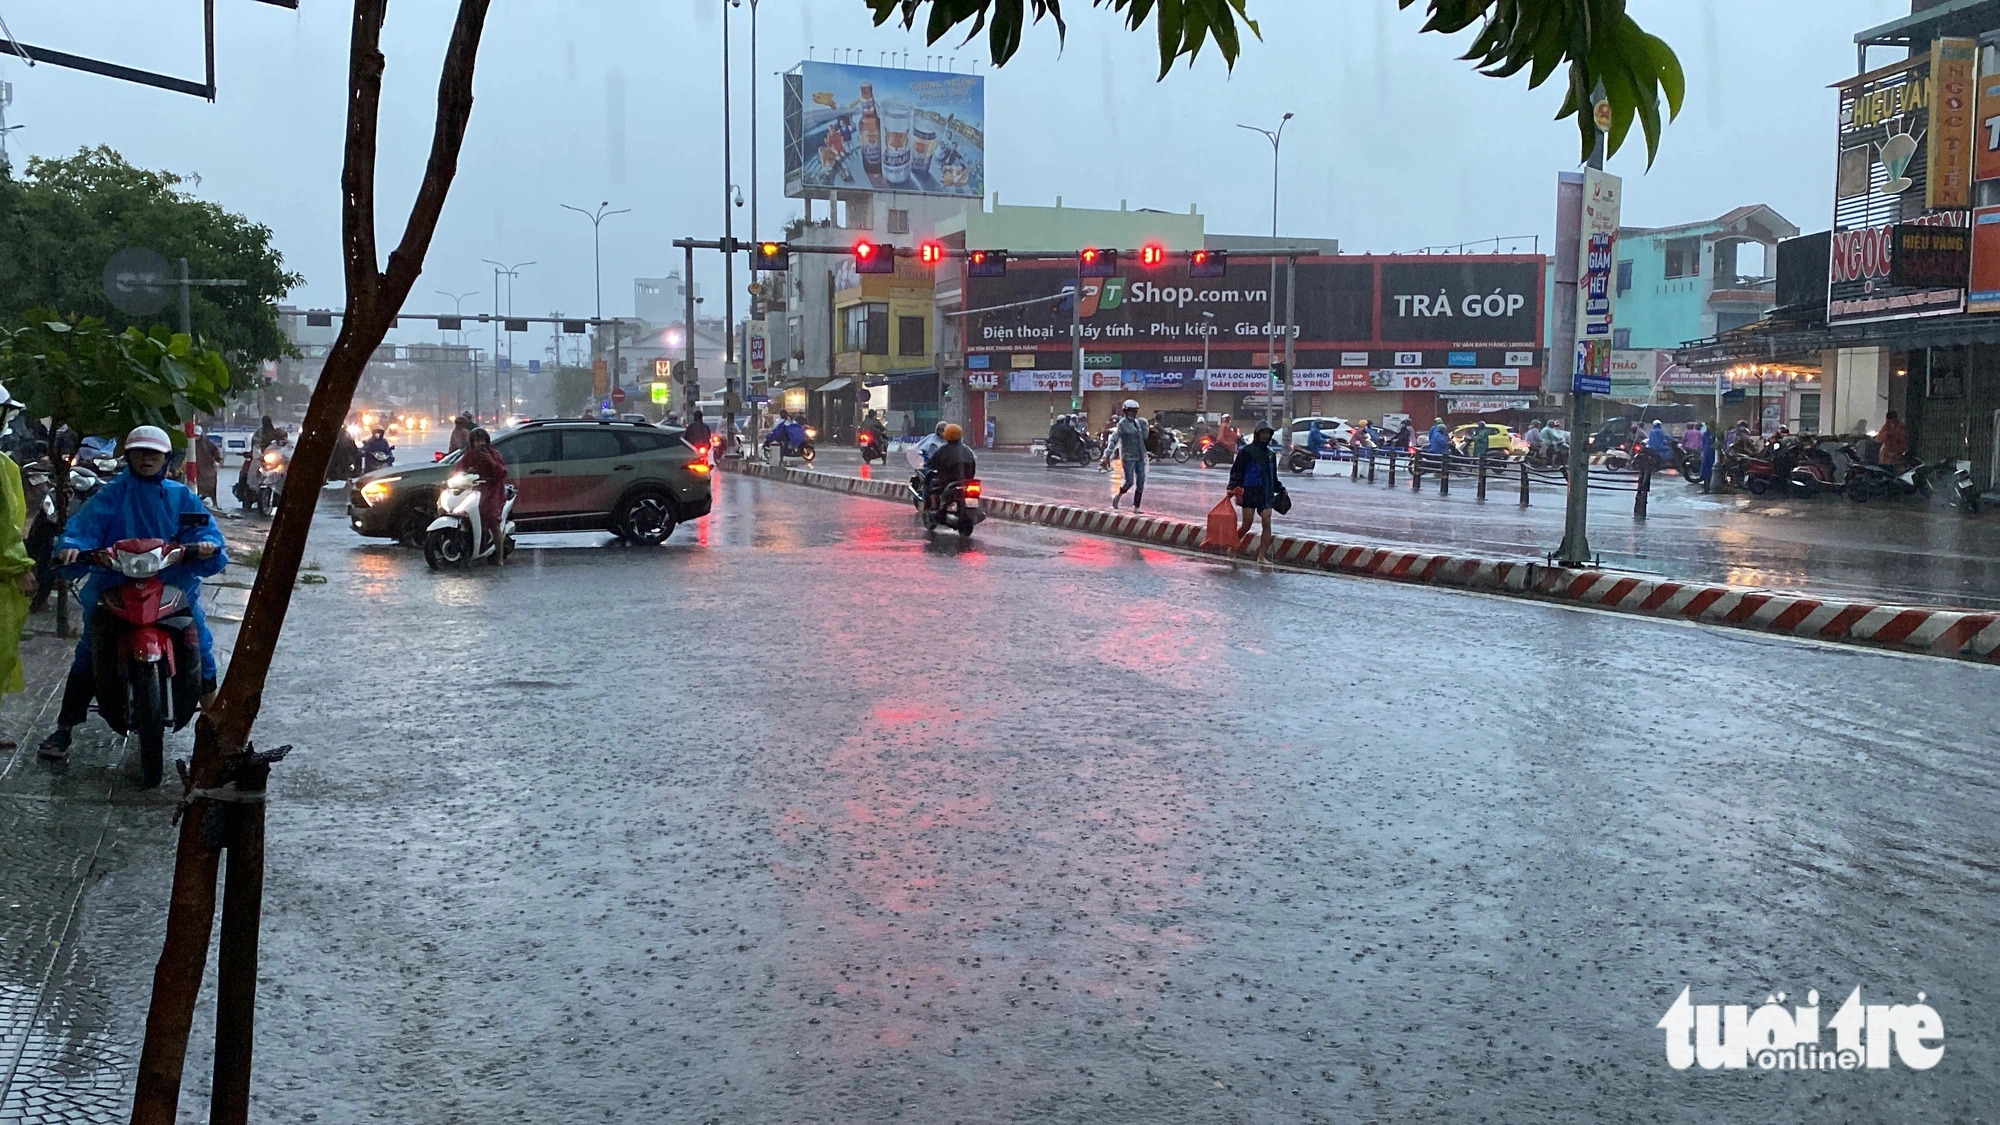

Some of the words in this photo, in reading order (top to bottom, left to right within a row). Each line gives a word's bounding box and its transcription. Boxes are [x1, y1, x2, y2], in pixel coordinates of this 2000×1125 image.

[1899, 71, 1931, 113] VÀN
[1590, 272, 1606, 294] HẾT
[1394, 288, 1453, 318] TRẢ
[1461, 287, 1525, 317] GÓP
[984, 324, 1013, 341] Điện
[1017, 323, 1054, 341] thoại
[1105, 321, 1134, 338] tính
[1150, 322, 1180, 339] Phụ
[1184, 321, 1218, 339] kiện
[1235, 322, 1258, 336] Gia
[1083, 355, 1112, 363] oppo
[1163, 355, 1203, 363] SAMSUNG
[1611, 360, 1637, 370] THẢO
[1032, 372, 1056, 380] Reno12
[1161, 372, 1183, 382] LỌC
[1211, 371, 1227, 379] MÁY
[1228, 372, 1243, 380] LỌC
[1302, 370, 1315, 379] ĐỔI
[1316, 370, 1330, 379] MỚI
[968, 375, 998, 386] SALE
[1210, 379, 1231, 388] GIẢM
[1232, 379, 1249, 388] ĐẾN
[1304, 379, 1331, 389] TRIỆU
[1334, 379, 1352, 388] NHẬP
[1353, 380, 1367, 388] HỌC
[1403, 376, 1436, 388] 10%
